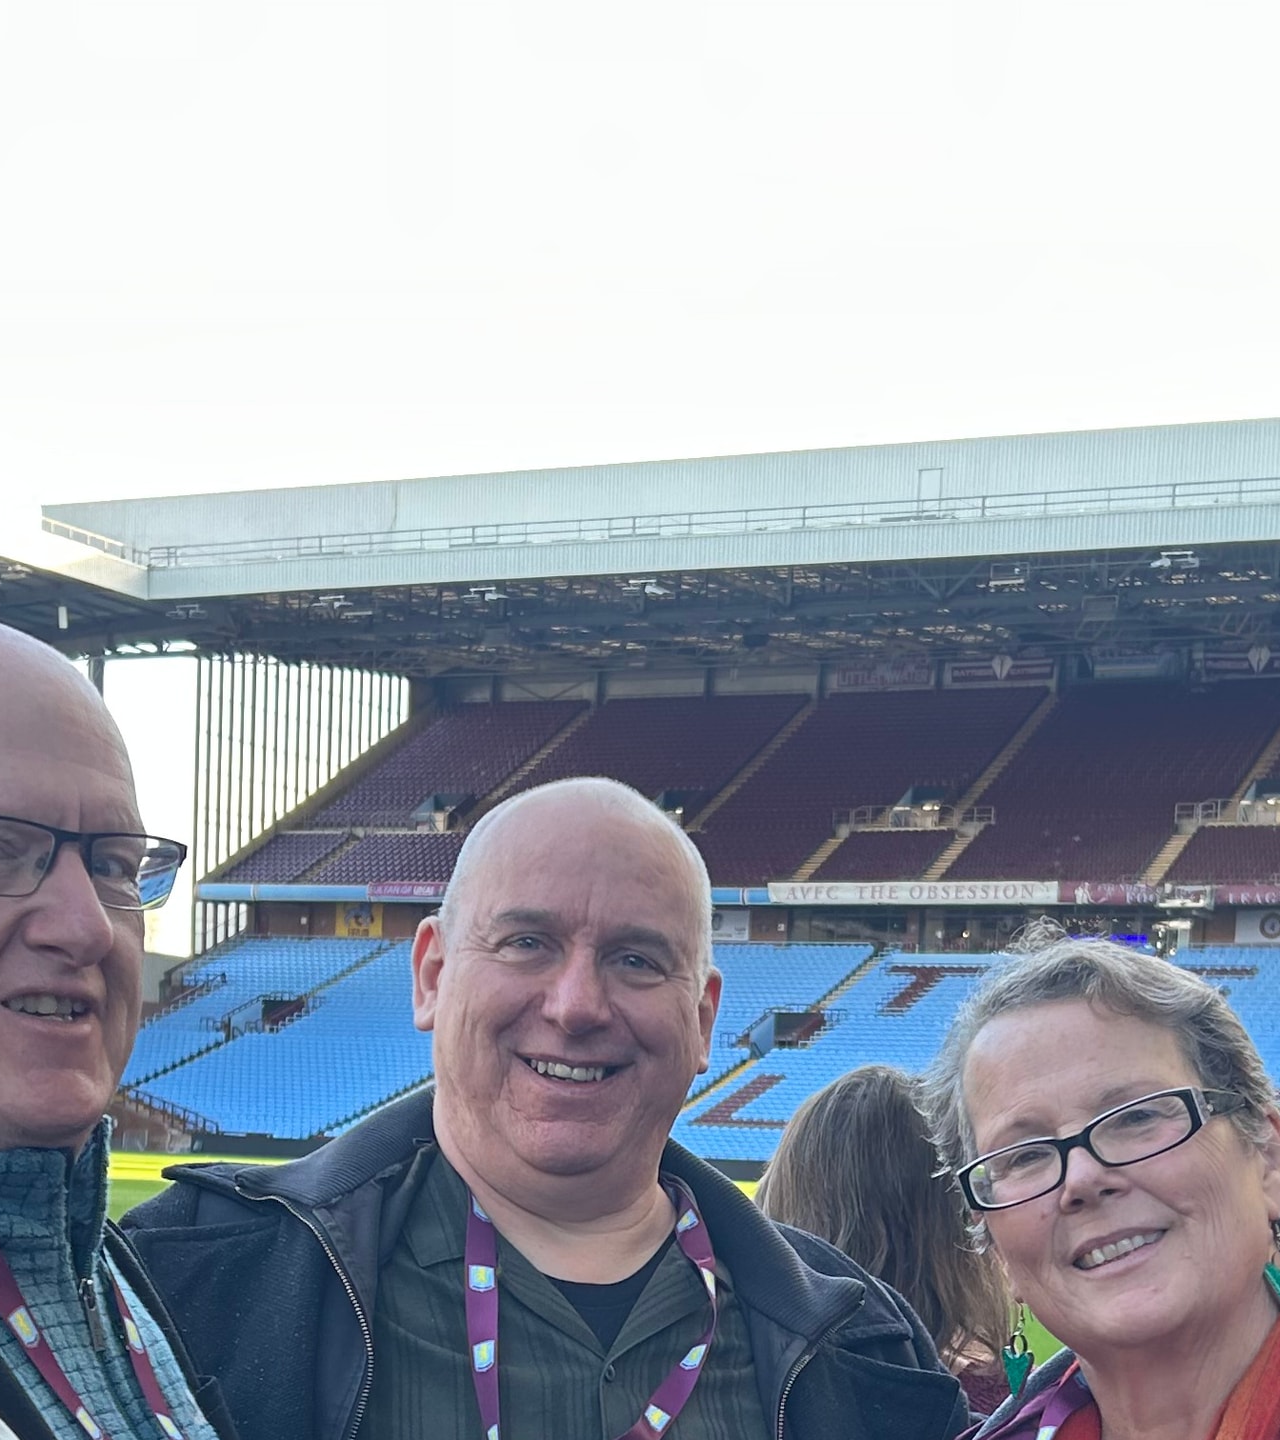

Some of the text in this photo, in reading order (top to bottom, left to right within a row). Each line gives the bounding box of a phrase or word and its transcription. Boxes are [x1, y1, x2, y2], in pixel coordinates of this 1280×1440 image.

[786, 884, 1036, 900] AVFC THE OBSESSION
